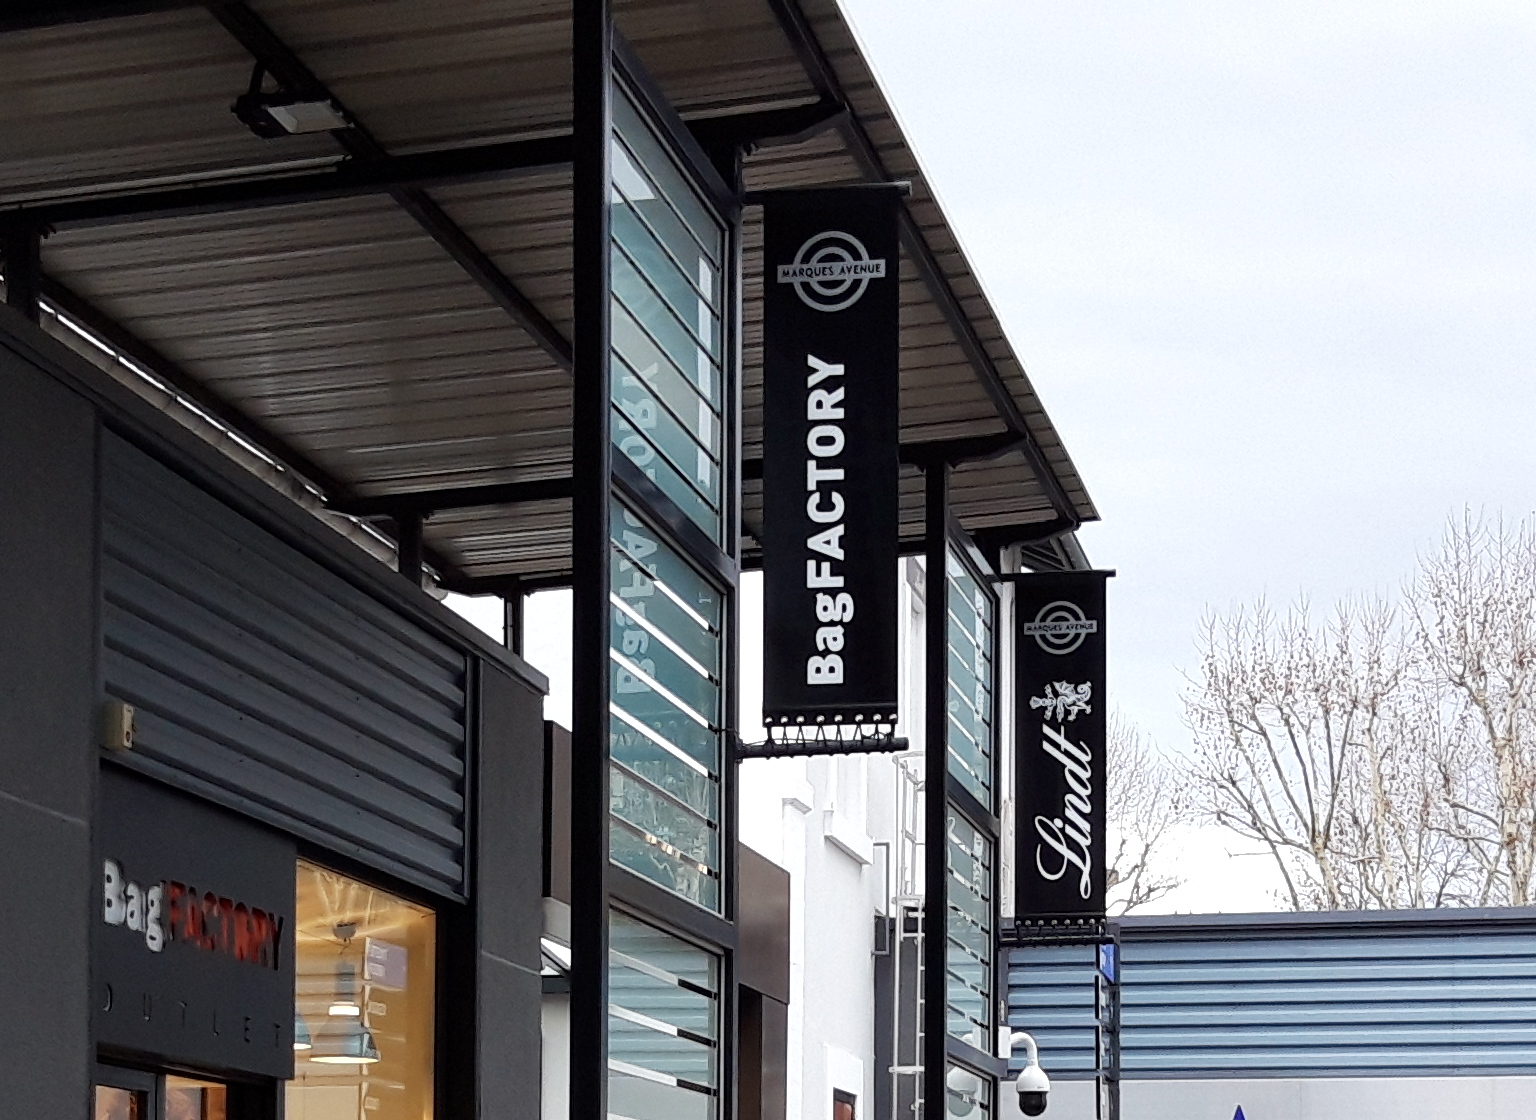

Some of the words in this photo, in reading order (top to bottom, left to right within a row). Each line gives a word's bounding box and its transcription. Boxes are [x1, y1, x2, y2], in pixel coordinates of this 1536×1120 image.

[782, 266, 834, 279] MARQUES
[839, 263, 882, 276] AVENUE
[807, 354, 854, 685] BagFACTORY
[1034, 723, 1092, 900] Lindt
